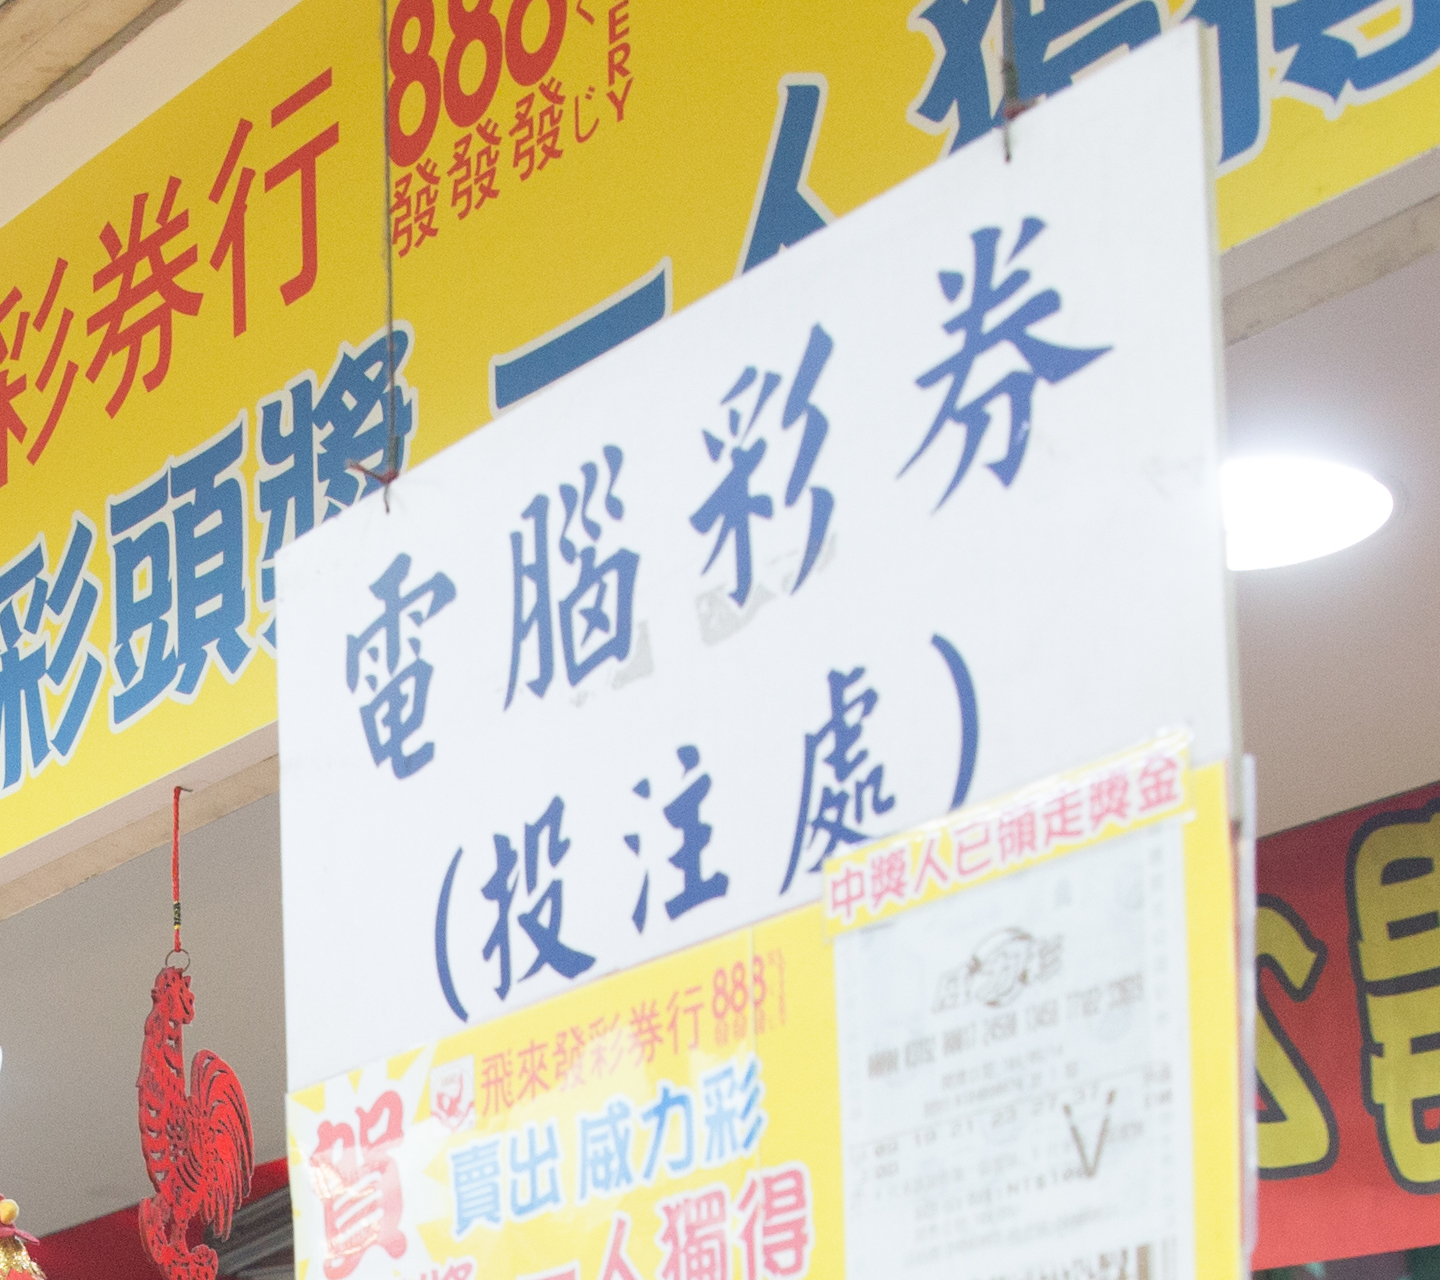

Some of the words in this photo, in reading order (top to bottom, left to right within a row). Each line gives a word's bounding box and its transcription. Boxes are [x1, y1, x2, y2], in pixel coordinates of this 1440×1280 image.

[390, 77, 566, 258] 發發發
[344, 216, 1114, 780] 電腦彩券
[433, 632, 979, 1022] (投注處)
[828, 754, 1184, 921] 中獎人已領走獎金
[481, 984, 706, 1117] 飛來發彩券行
[450, 1121, 560, 1238] 賣出
[579, 1058, 766, 1202] 威力彩
